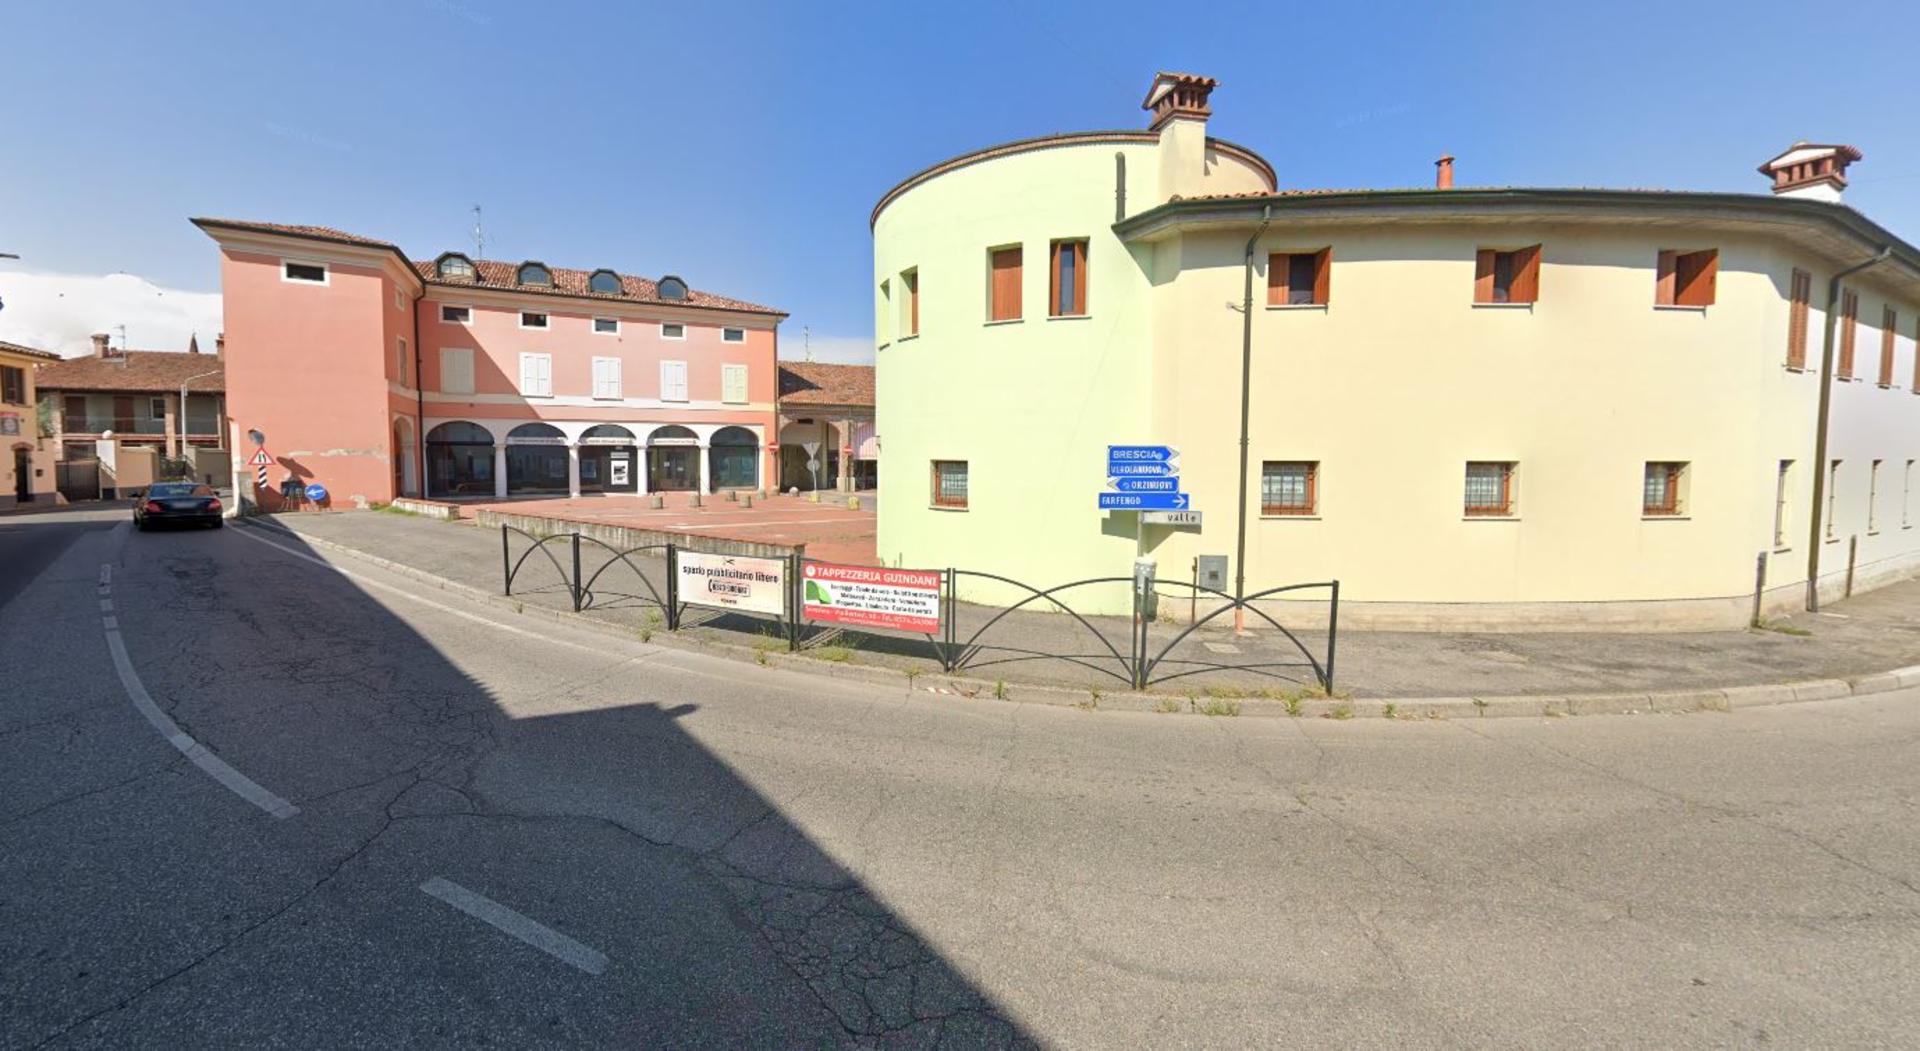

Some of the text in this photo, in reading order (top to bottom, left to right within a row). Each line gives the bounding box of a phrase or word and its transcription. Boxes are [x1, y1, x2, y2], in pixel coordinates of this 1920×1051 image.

[1113, 450, 1157, 459] BRESCIA
[1131, 481, 1173, 489] ORZINUOVI
[1102, 496, 1141, 505] FARFENGO
[683, 566, 778, 583] spazio pubblicitario libero
[817, 567, 937, 586] TAPPEZZERIA GUINDANI
